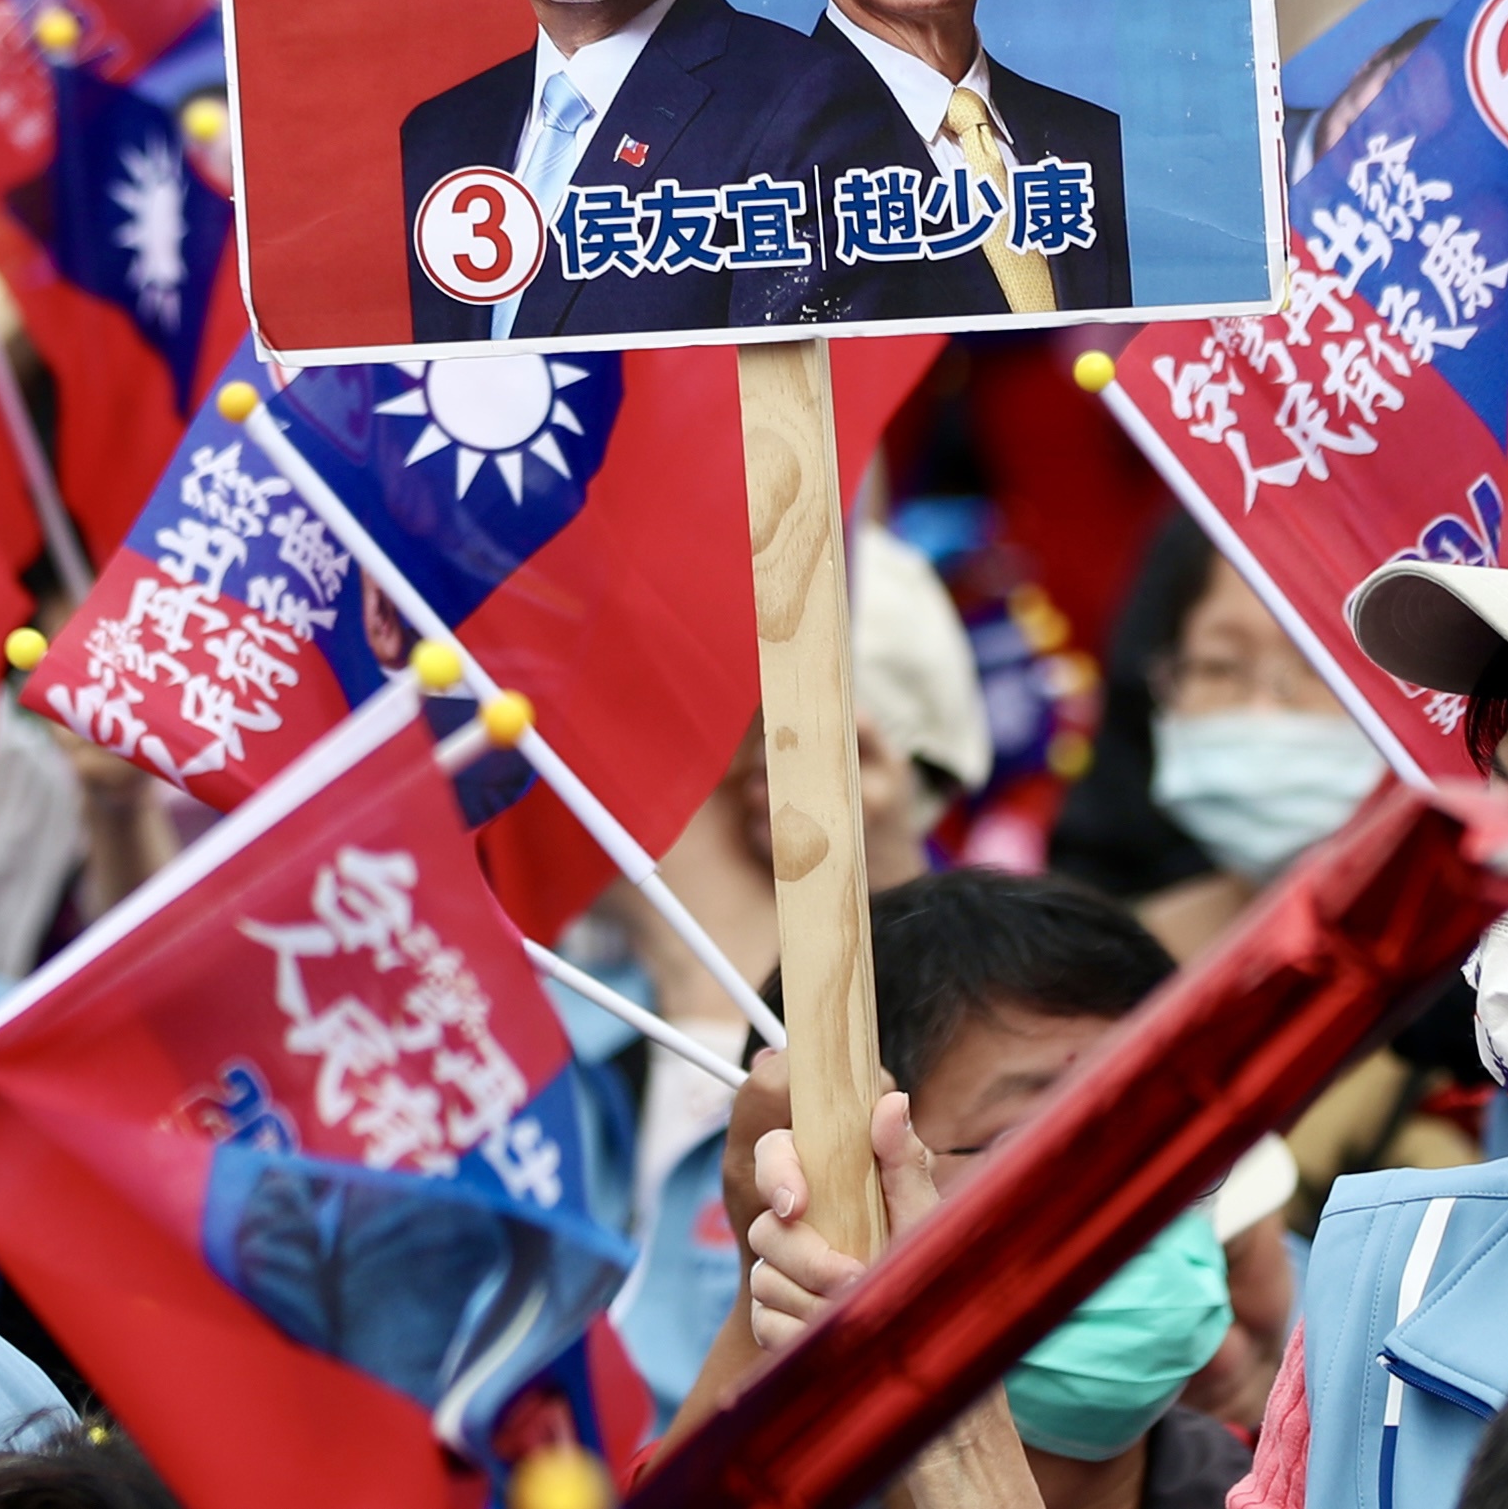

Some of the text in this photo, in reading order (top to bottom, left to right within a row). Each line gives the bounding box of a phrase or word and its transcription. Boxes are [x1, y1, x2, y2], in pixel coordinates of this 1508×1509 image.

[452, 183, 514, 282] 3
[551, 176, 811, 276] 侯友宜
[836, 160, 1095, 264] 趙少康
